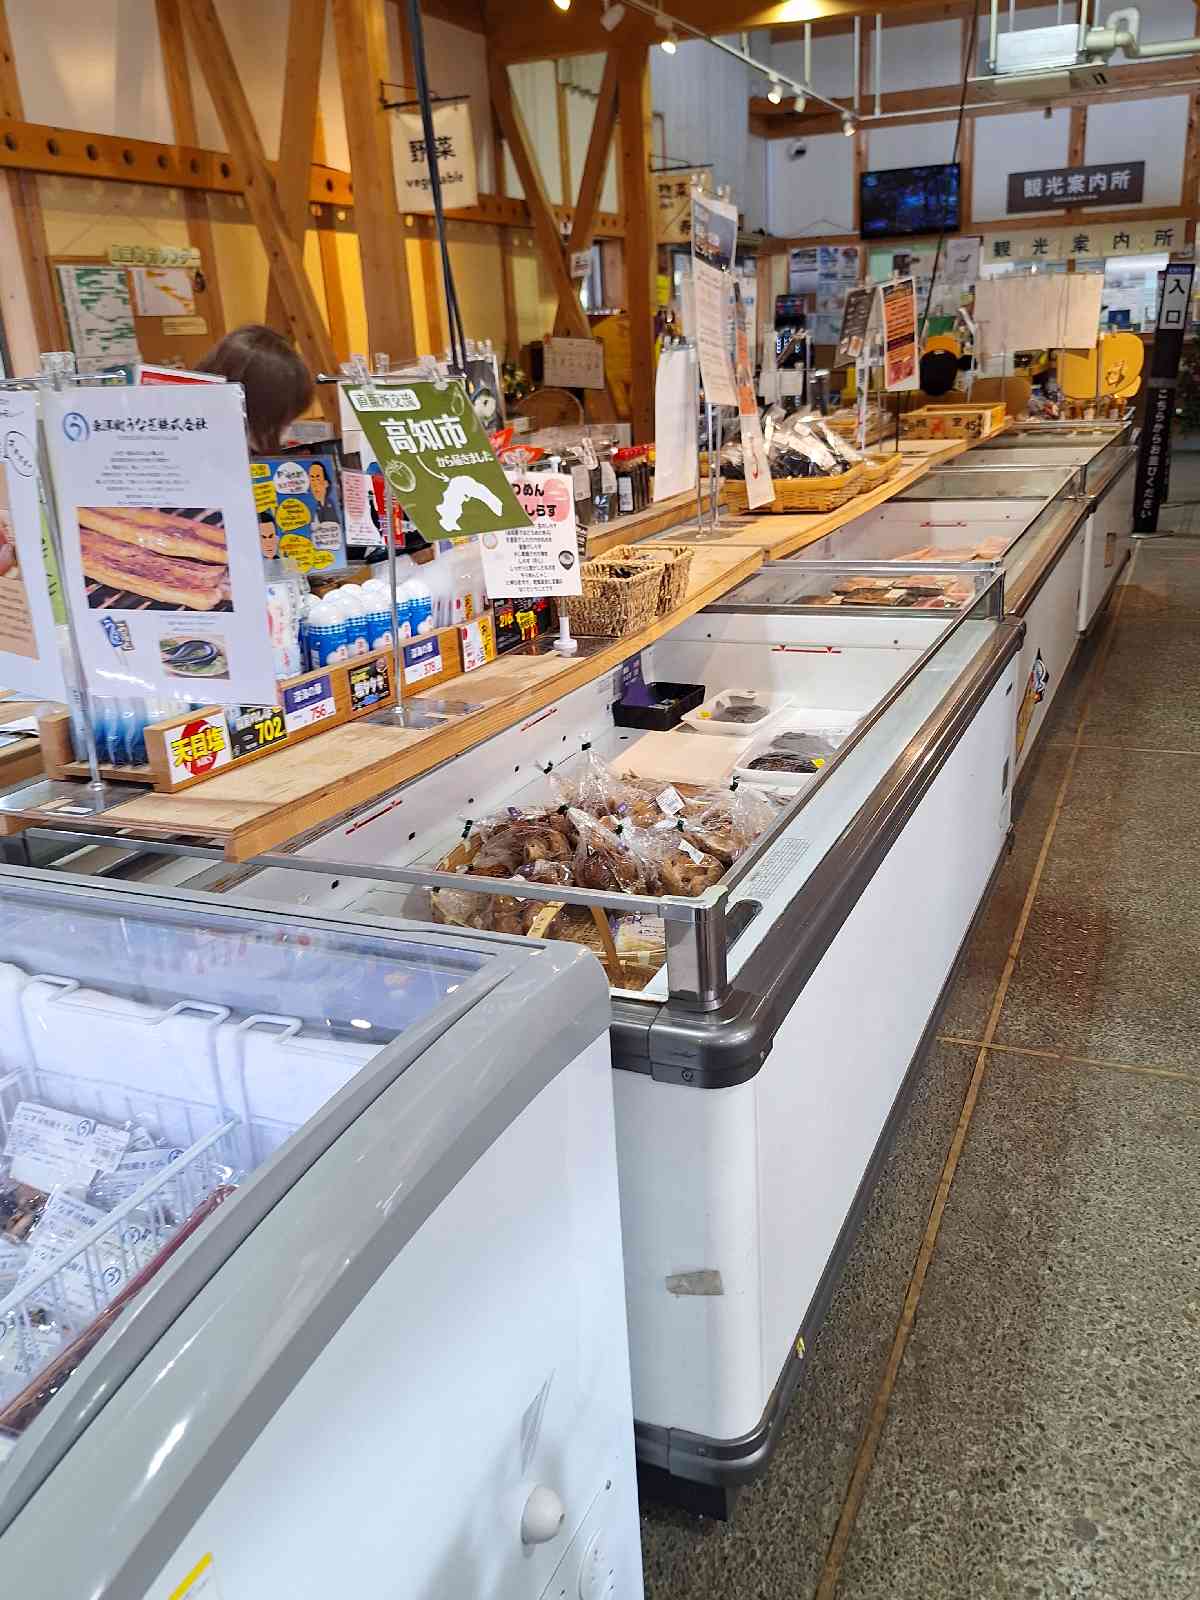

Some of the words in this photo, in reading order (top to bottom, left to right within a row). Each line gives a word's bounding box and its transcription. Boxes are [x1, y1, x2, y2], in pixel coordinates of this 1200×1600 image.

[406, 171, 464, 190] vegable
[1023, 169, 1132, 199] 観光案内所
[1166, 278, 1186, 324] 入口
[379, 414, 468, 455] 高知市
[254, 716, 283, 745] 702
